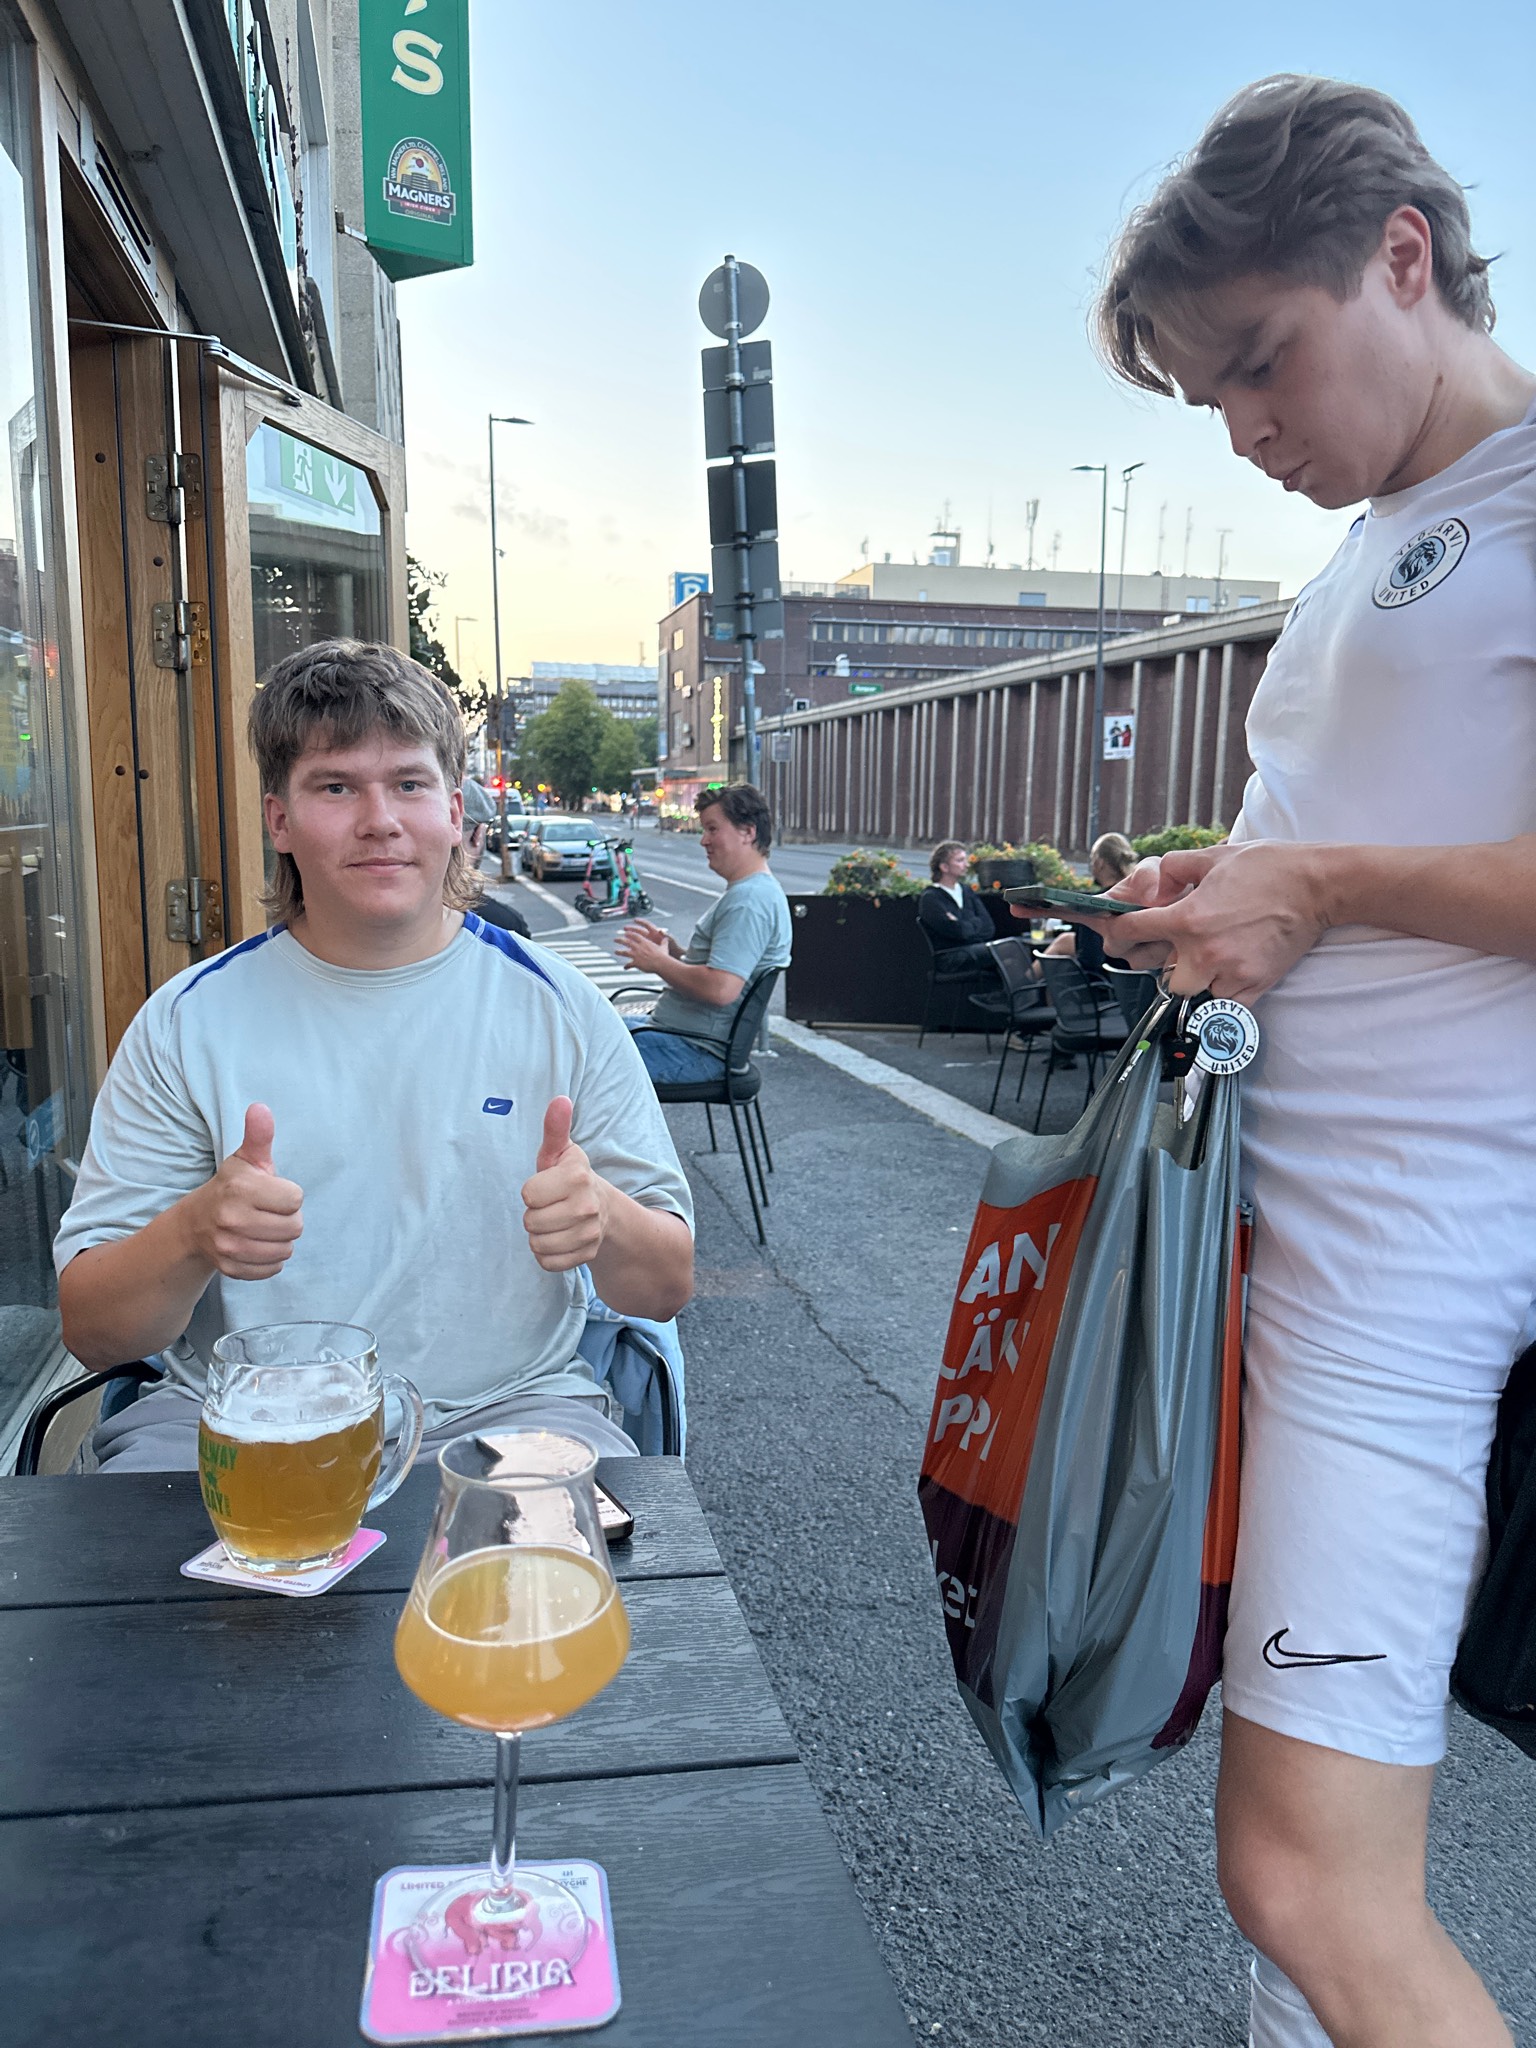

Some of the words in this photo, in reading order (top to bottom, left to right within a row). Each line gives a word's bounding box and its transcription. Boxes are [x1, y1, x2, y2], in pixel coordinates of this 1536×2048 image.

[388, 182, 451, 209] MAGNERS
[1379, 580, 1429, 603] UNITED
[1211, 1044, 1255, 1073] UNITED
[401, 1881, 445, 1890] LIMITED
[410, 1958, 576, 1997] DELIRIA
